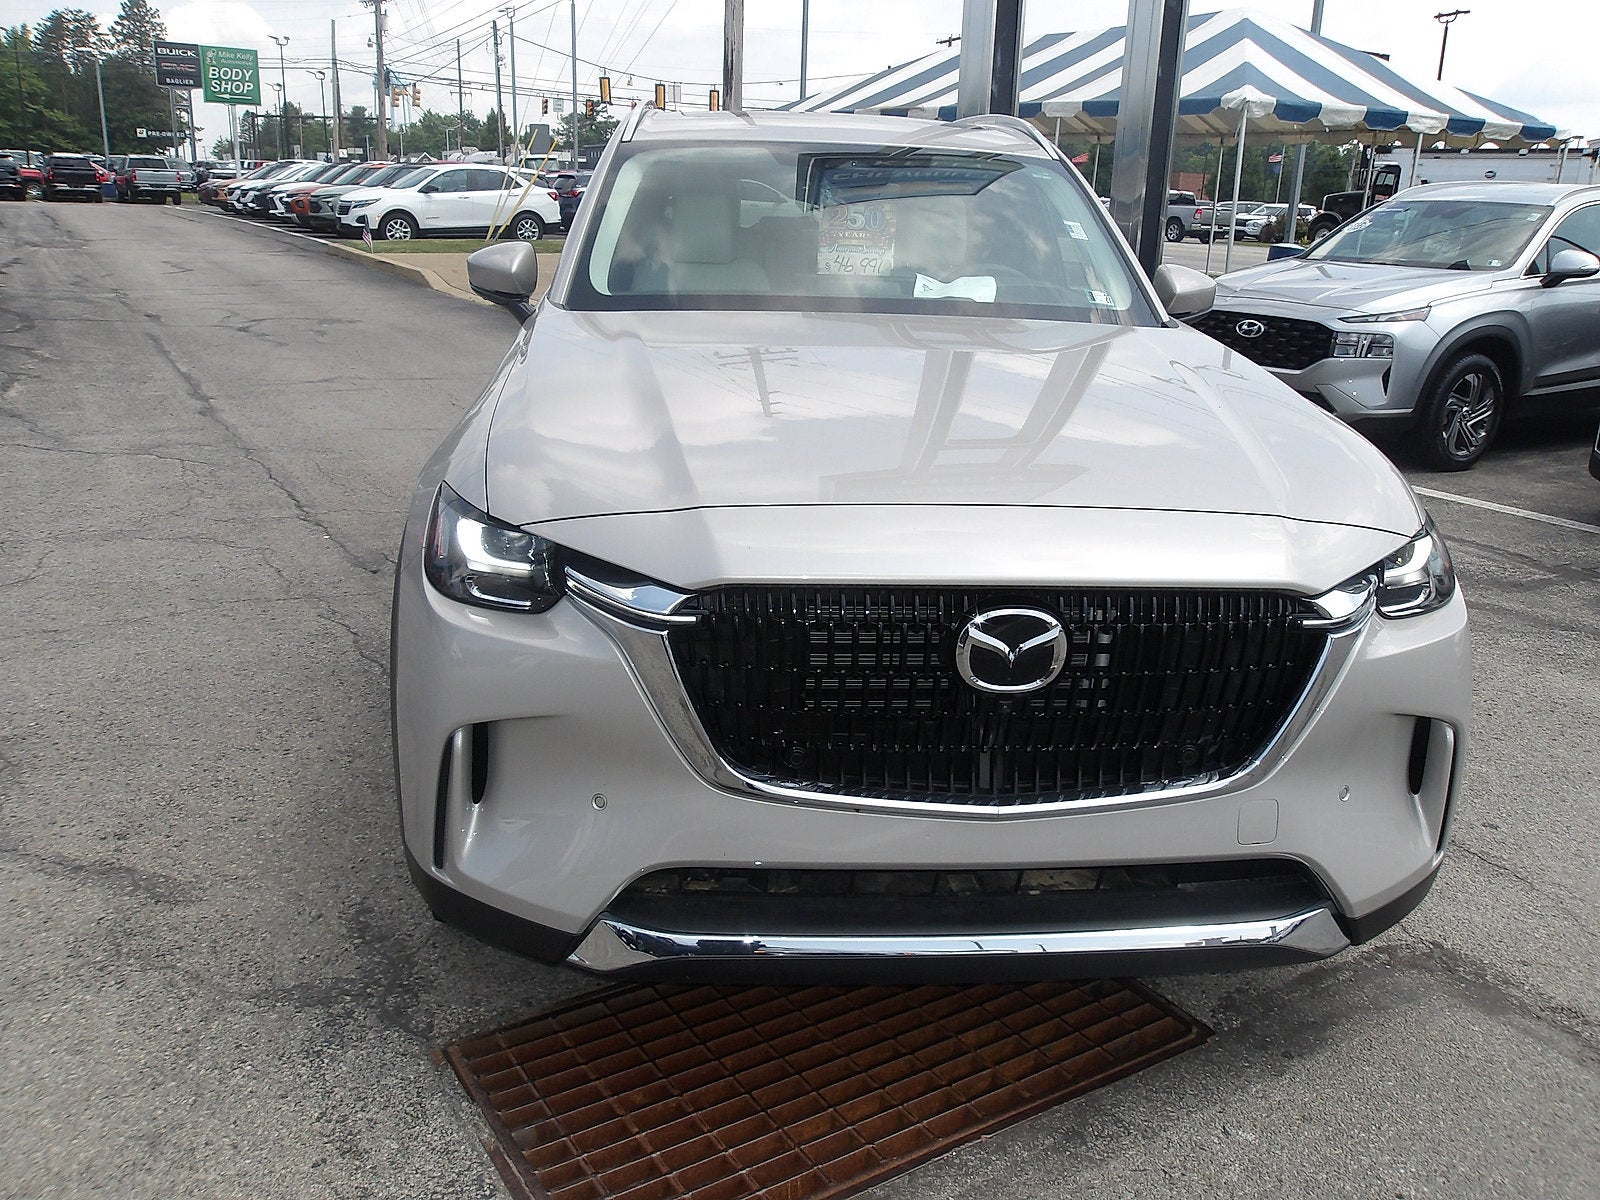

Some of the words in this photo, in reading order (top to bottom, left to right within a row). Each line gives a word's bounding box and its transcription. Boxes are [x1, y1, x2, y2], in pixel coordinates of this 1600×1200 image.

[157, 47, 197, 57] BUICK
[208, 66, 253, 81] BODY
[210, 80, 254, 94] SHOP
[827, 205, 886, 232] 250
